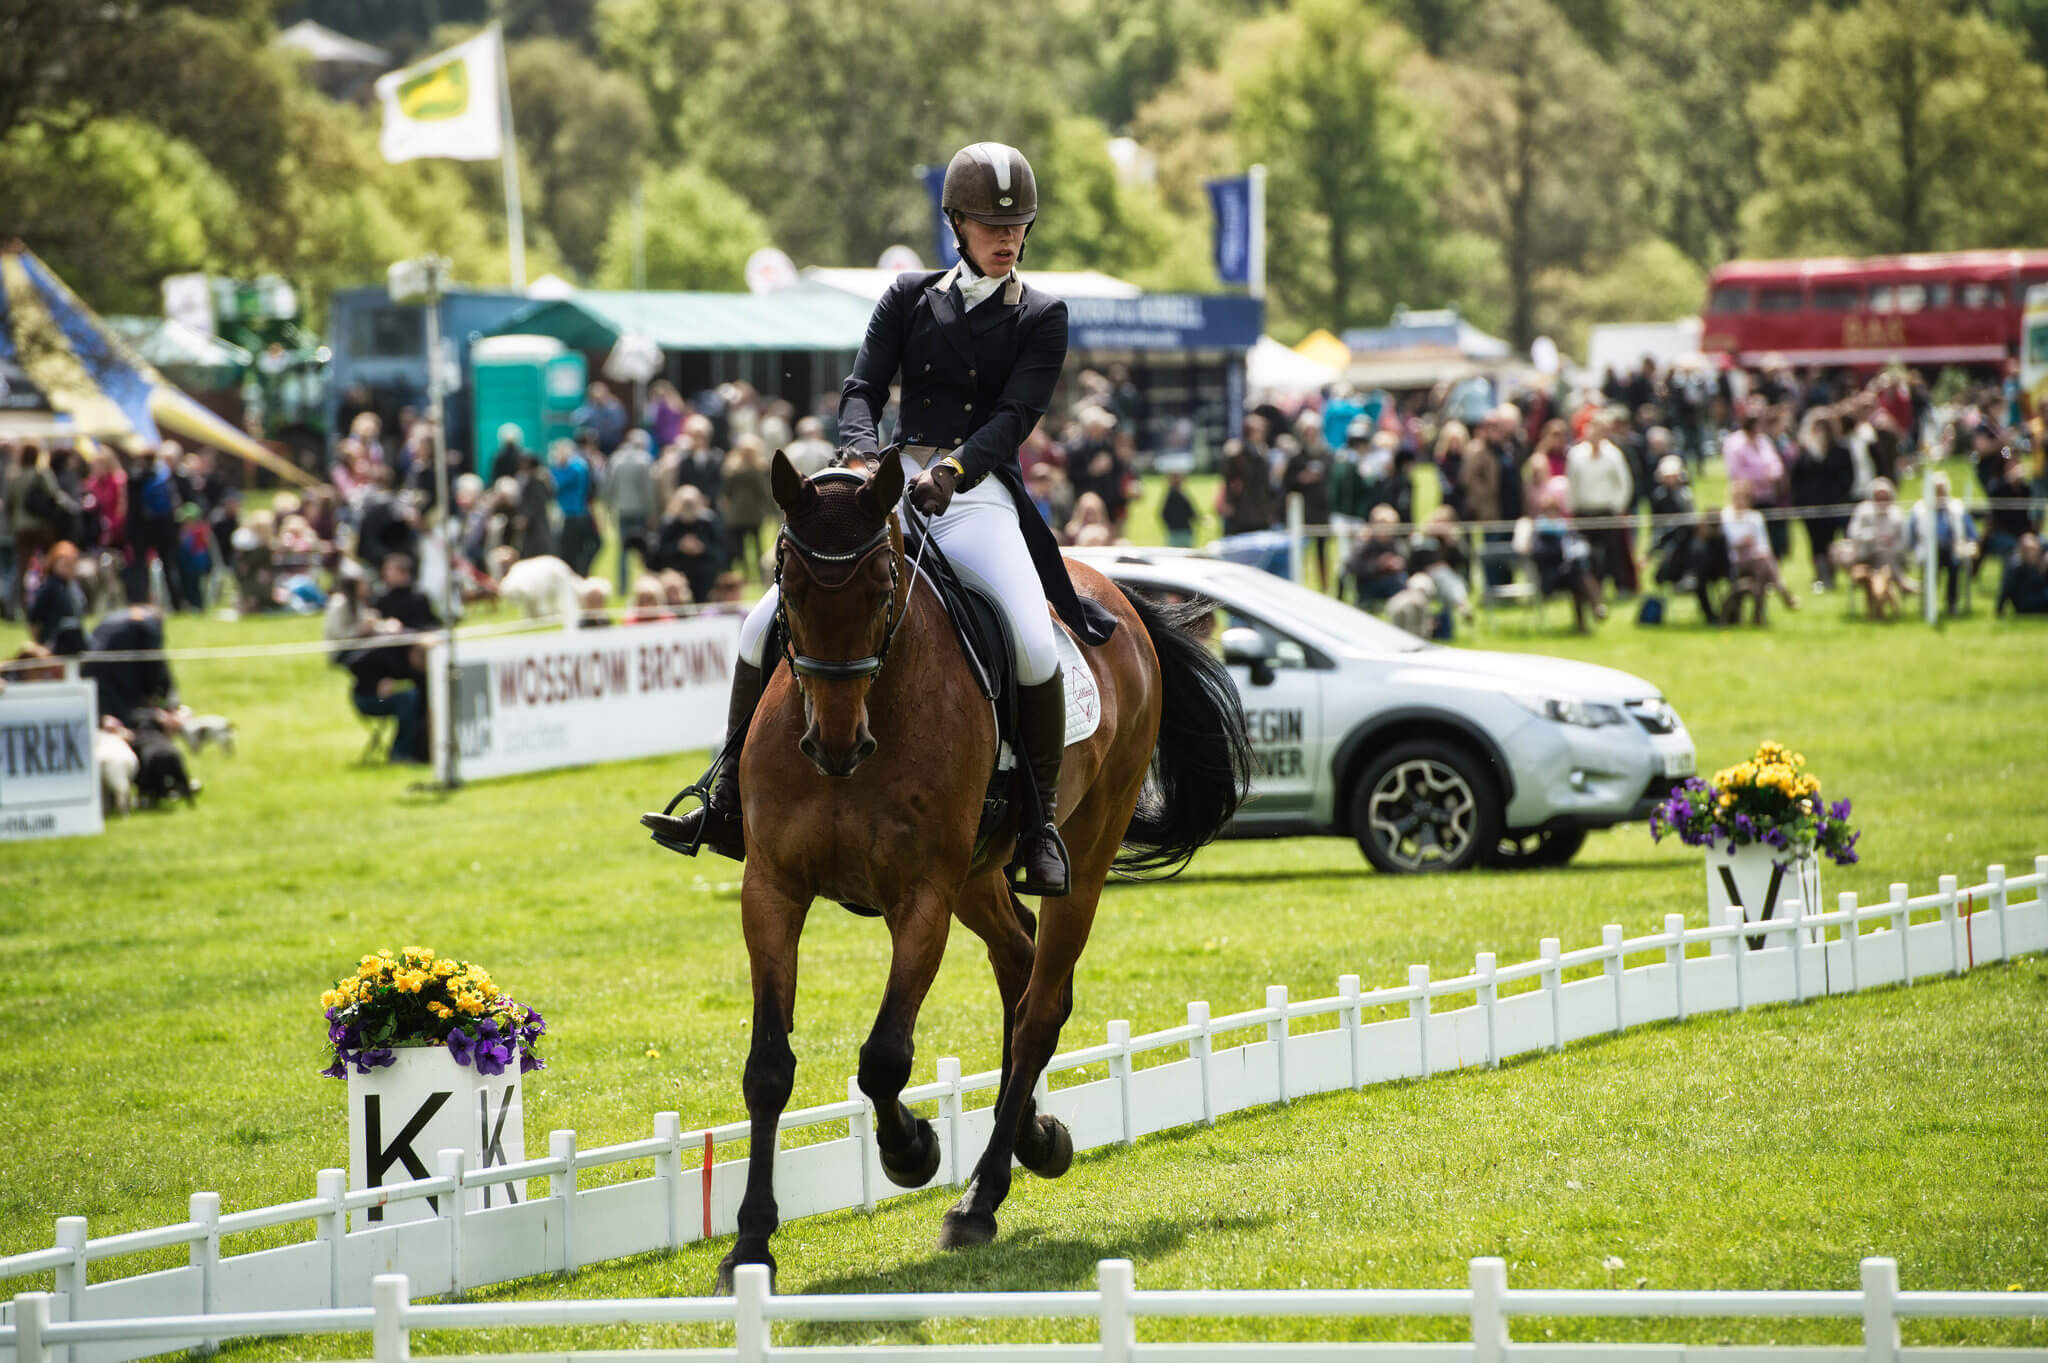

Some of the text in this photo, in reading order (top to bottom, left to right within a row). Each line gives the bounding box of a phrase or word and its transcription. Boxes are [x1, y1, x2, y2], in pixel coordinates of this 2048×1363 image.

[1842, 316, 1905, 347] BAR
[637, 640, 728, 693] BROWN
[1245, 708, 1304, 744] EGIN
[1718, 864, 1785, 951] V
[365, 1091, 454, 1222] K
[480, 1084, 518, 1209] K
